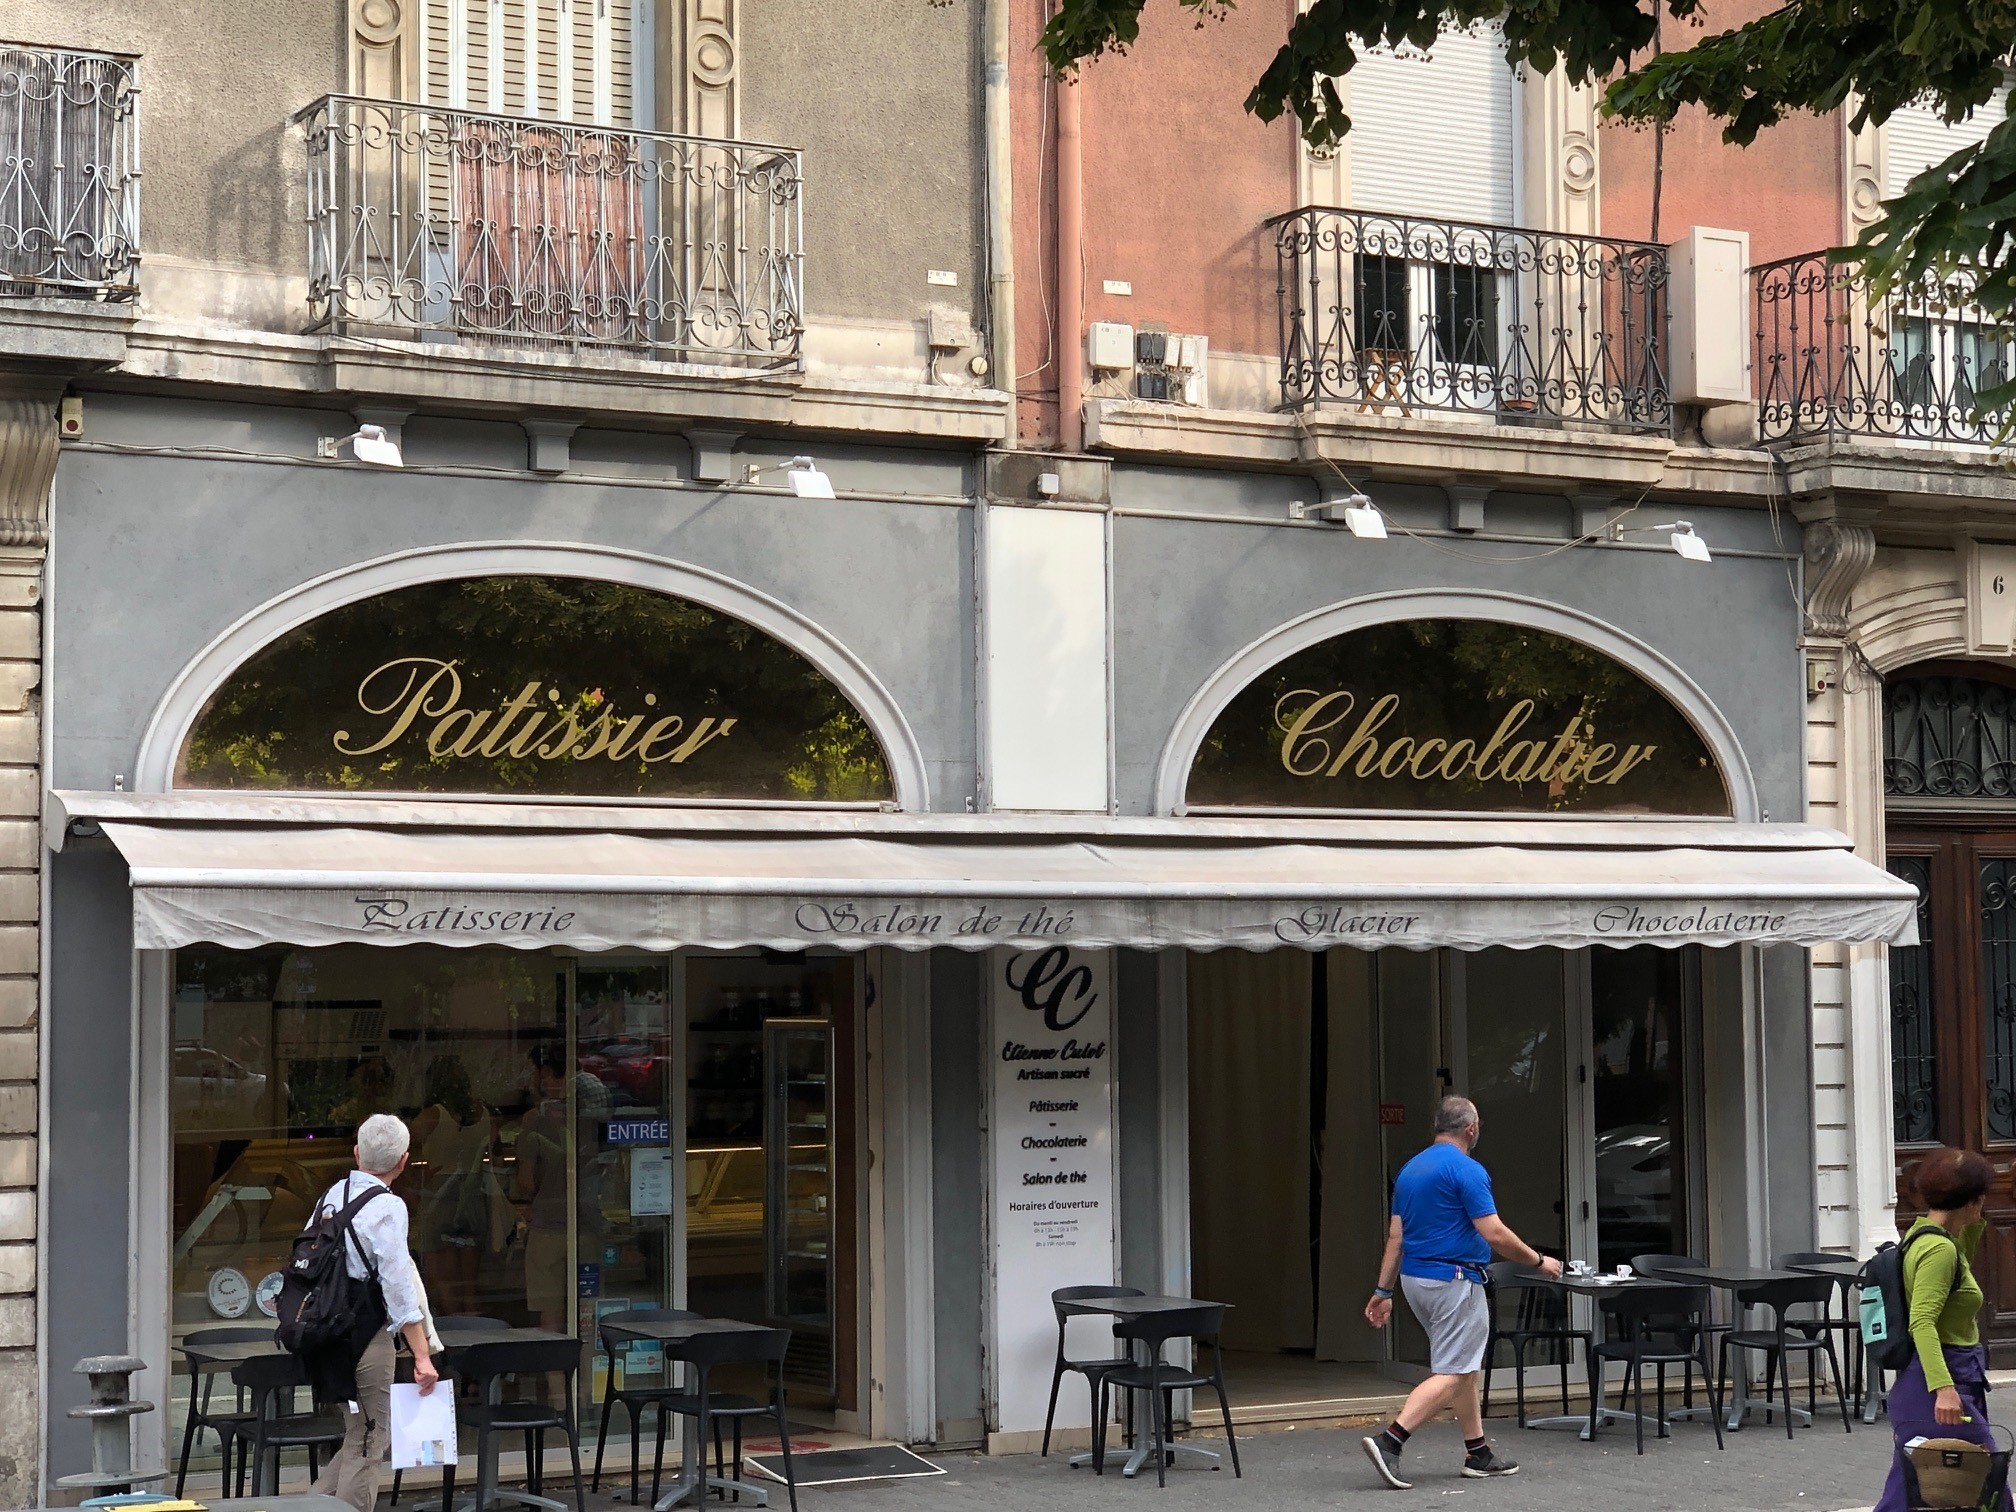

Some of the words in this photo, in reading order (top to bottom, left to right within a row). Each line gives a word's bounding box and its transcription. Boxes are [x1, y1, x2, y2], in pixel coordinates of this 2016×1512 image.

[1992, 575, 2004, 595] 6
[333, 657, 738, 763] Patissier
[1275, 690, 1658, 785] Chocolatier
[354, 896, 576, 931] Patisserie
[795, 902, 942, 933] Salon
[958, 905, 1002, 934] de
[1017, 905, 1075, 935] thé
[1593, 905, 1786, 932] Chocolaterie
[1274, 905, 1420, 943] Glacier
[1017, 1068, 1059, 1081] Artisan
[1059, 1066, 1090, 1080] sucré
[1029, 1099, 1079, 1112] Pâtisserie
[608, 1121, 669, 1140] ENTRÉE
[1021, 1135, 1088, 1149] Chocolaterie
[1022, 1172, 1053, 1186] Salon
[1054, 1171, 1069, 1184] de
[1069, 1171, 1087, 1183] thé
[1009, 1201, 1047, 1212] Horaires
[1048, 1200, 1099, 1210] d'ouverture
